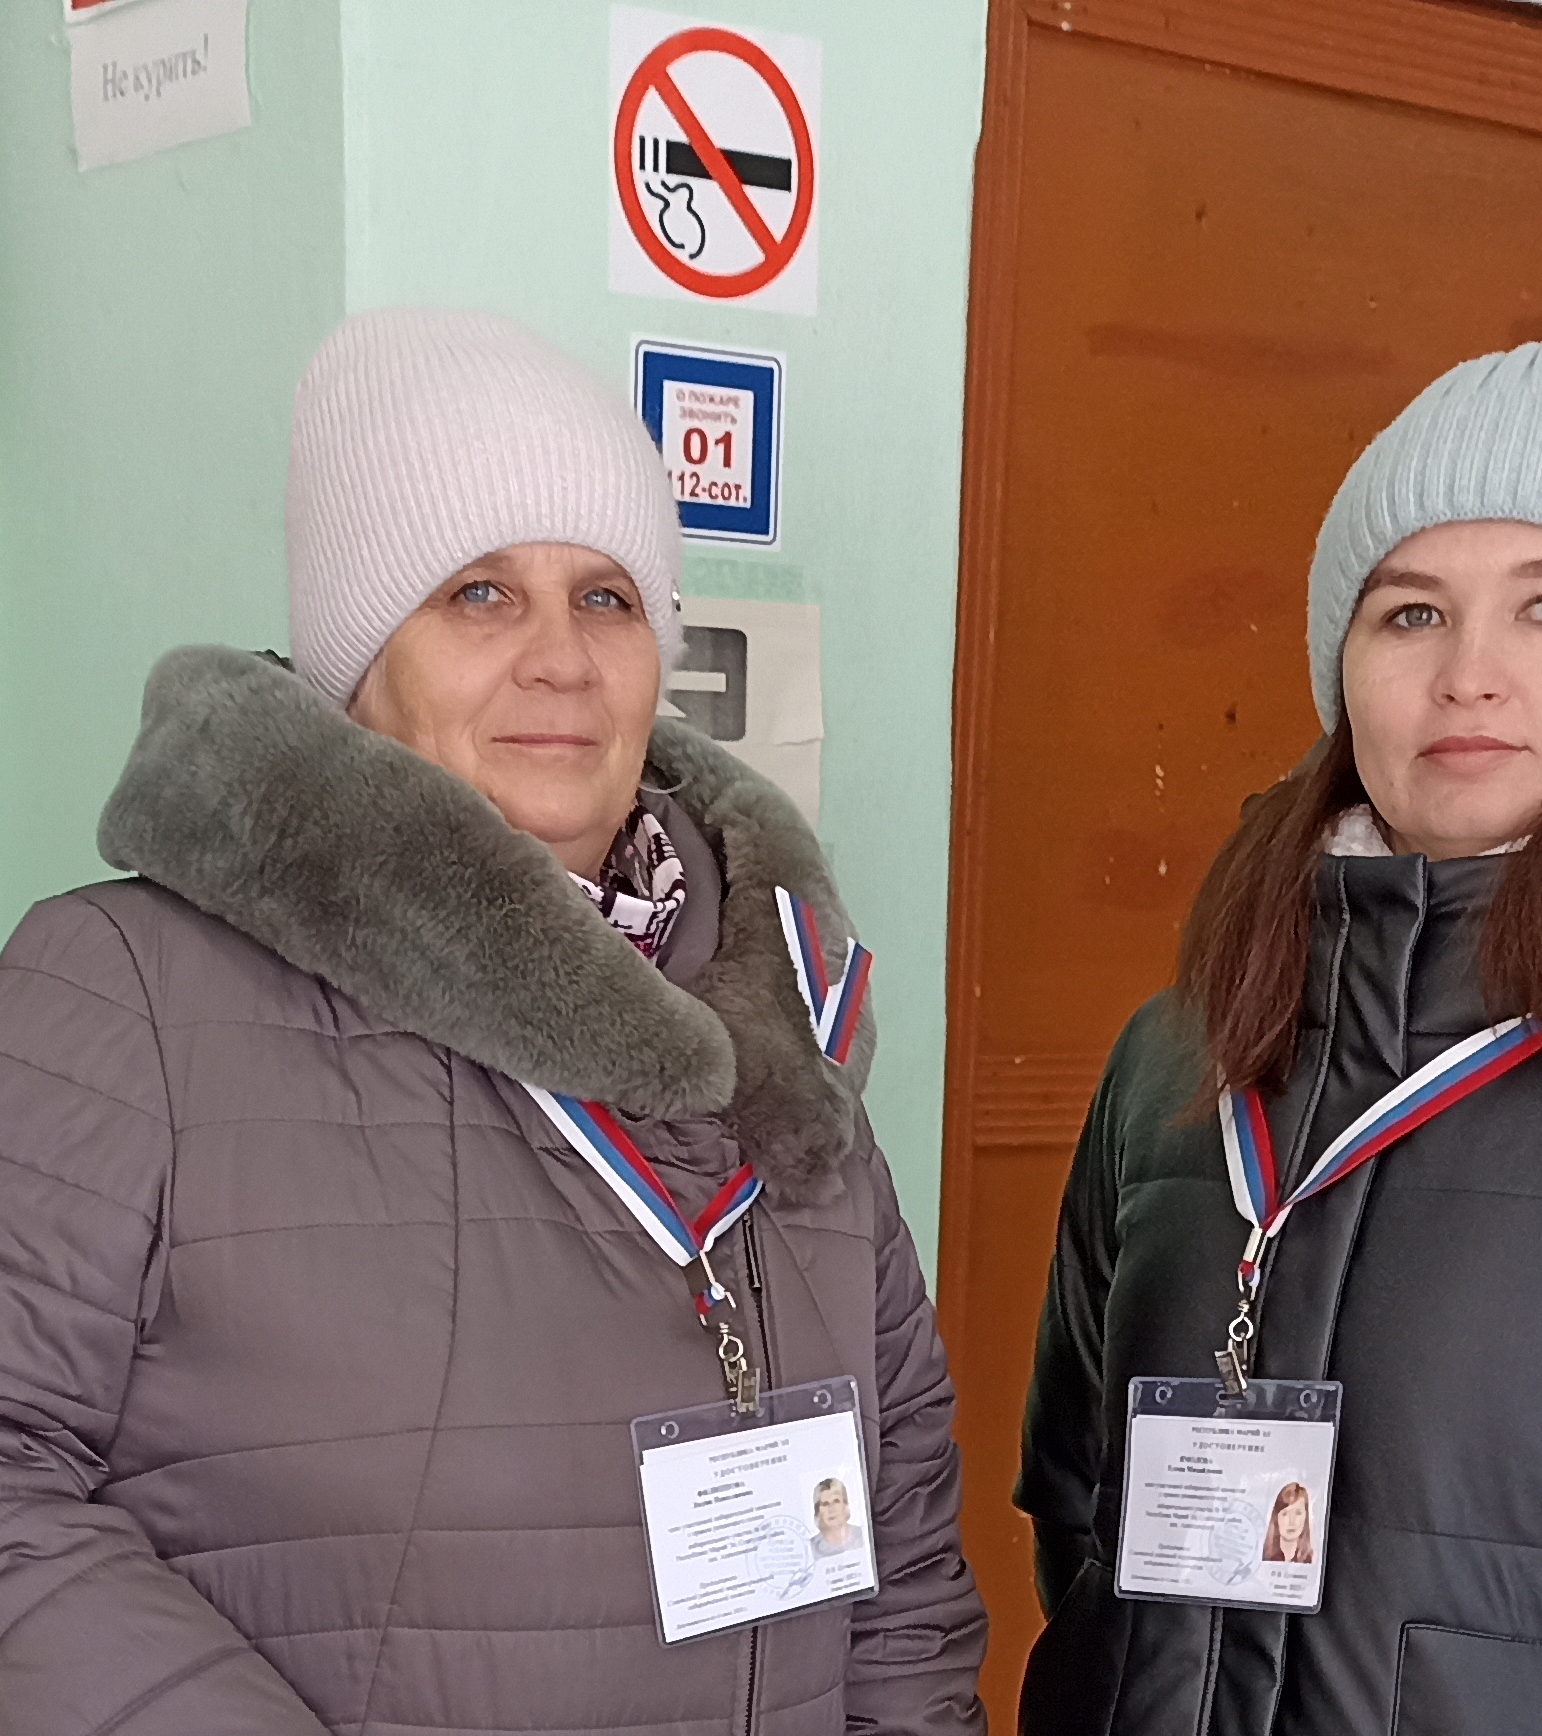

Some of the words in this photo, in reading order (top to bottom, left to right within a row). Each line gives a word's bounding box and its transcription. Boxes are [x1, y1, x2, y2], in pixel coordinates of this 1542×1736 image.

[101, 60, 128, 102] Не
[133, 33, 209, 102] курить!
[688, 389, 740, 409] ПОЖАРЕ
[682, 427, 733, 469] 01
